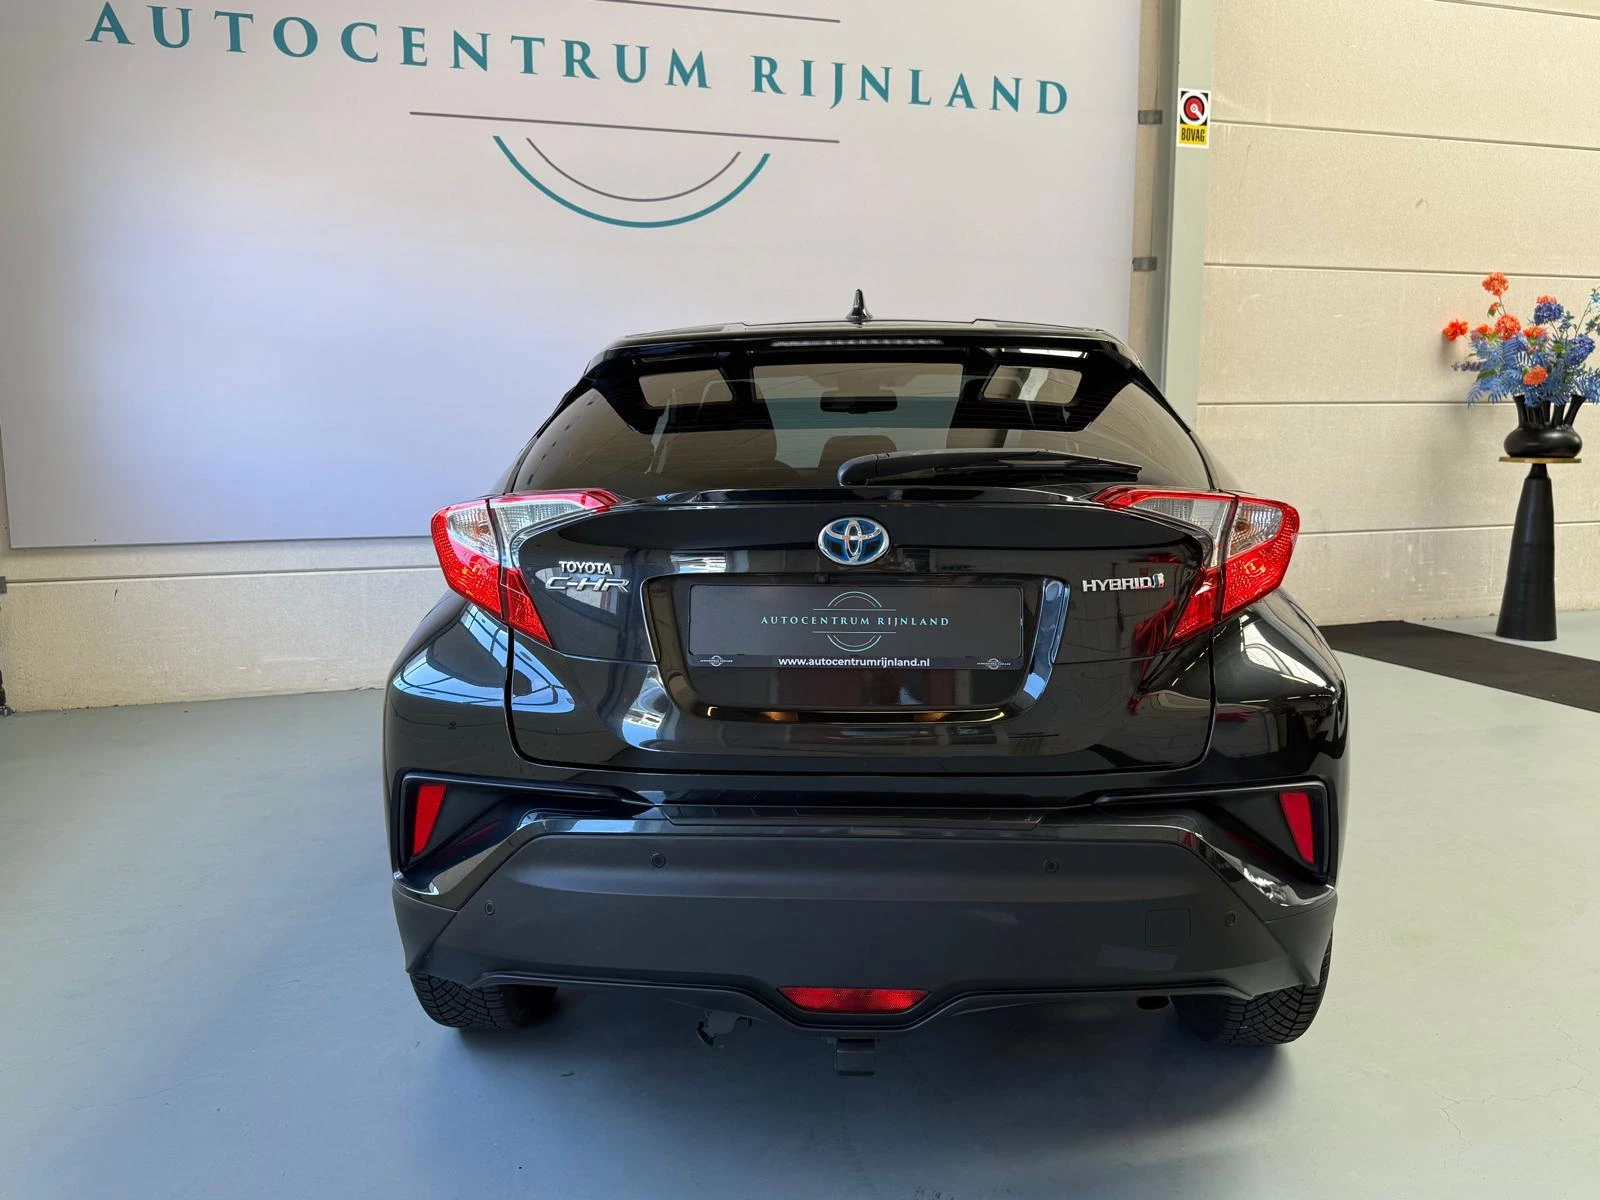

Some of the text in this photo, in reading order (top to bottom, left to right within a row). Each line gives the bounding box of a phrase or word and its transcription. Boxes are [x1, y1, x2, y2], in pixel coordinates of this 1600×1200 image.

[86, 2, 1068, 115] AUTOCENTRUM RIJNLAND
[1181, 128, 1205, 142] BOVAG
[558, 561, 614, 575] TOYOTA
[545, 576, 630, 593] C-HR
[760, 616, 950, 627] AUTOCENTRUM RIJNLAND
[778, 657, 931, 669] www.autocentrumrijnland.nl
